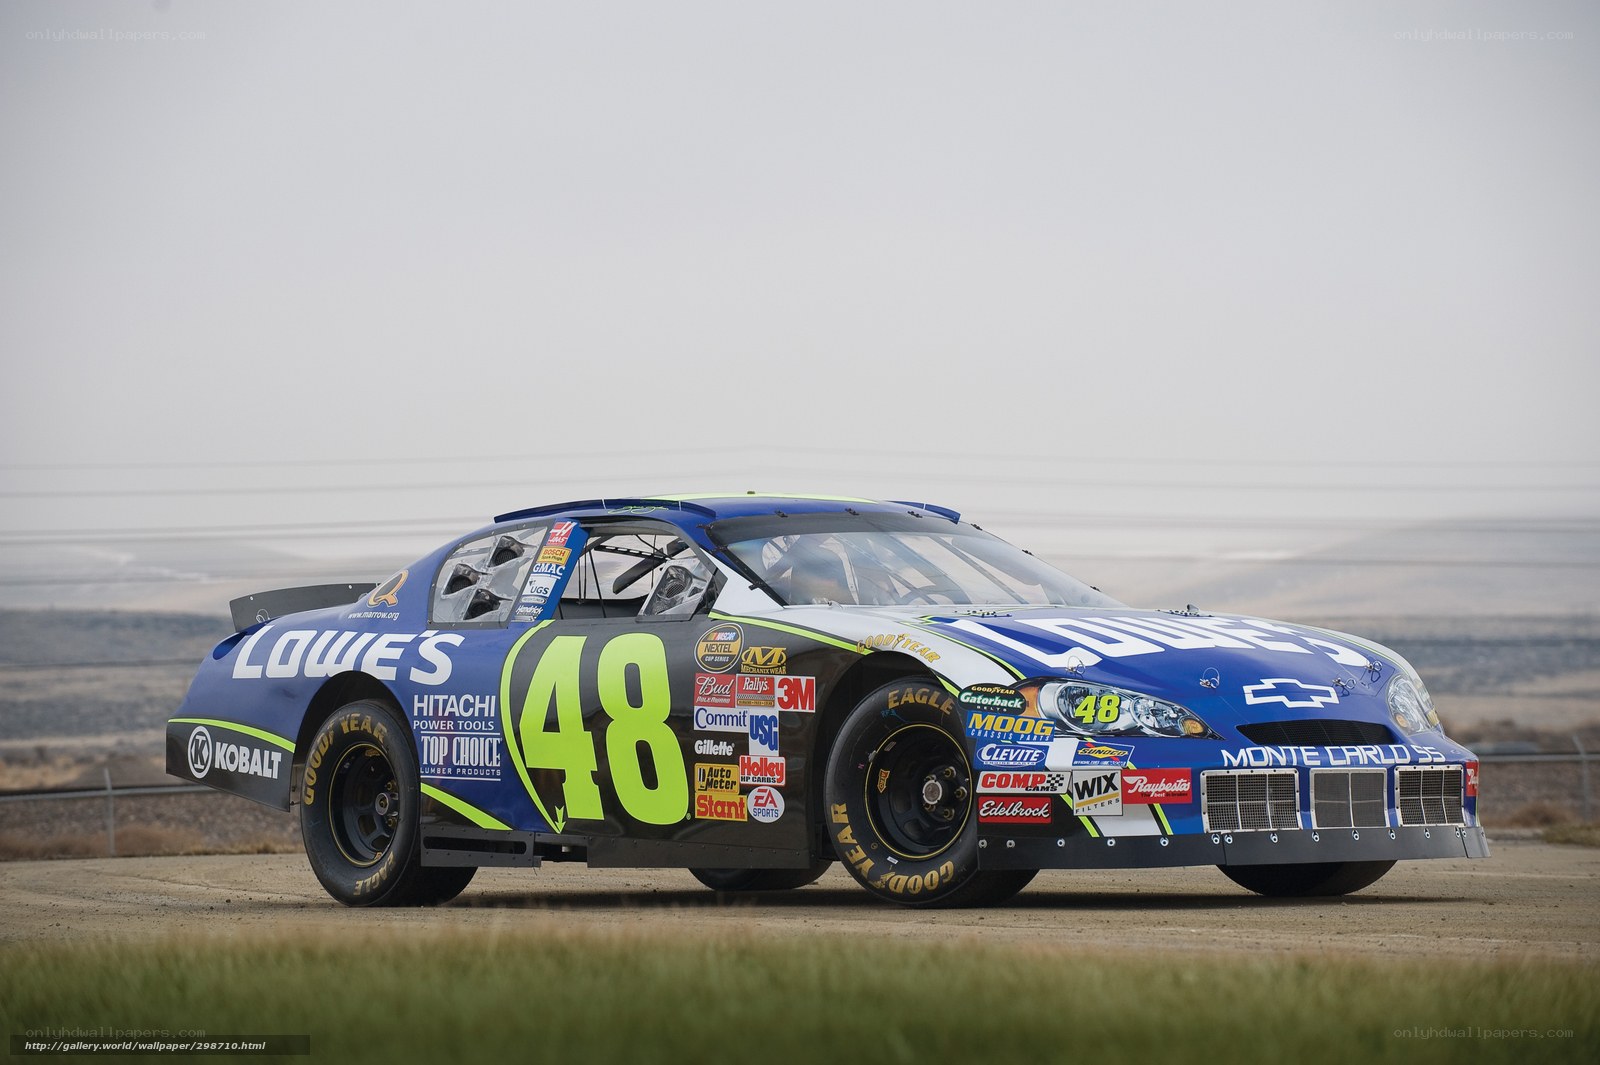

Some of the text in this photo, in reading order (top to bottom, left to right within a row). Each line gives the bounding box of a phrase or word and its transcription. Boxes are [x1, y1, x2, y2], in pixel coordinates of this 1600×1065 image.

[543, 549, 566, 557] BOSCH
[533, 563, 565, 575] GMAC
[530, 586, 549, 594] UGS
[348, 612, 400, 621] www.marrow.org
[516, 605, 543, 615] Hendrick
[714, 632, 736, 640] NASCAR
[232, 625, 465, 686] LOWE'S
[704, 644, 732, 653] NEXTEL
[741, 665, 787, 674] MECHANIX WEAR
[696, 676, 735, 695] Bud
[743, 677, 768, 693] Rally's
[971, 686, 1015, 695] GOODYEAR
[777, 678, 815, 710] 3M
[888, 688, 955, 715] EAGLE
[960, 692, 1023, 708] Gatorback
[413, 694, 496, 717] HITACHI
[1074, 695, 1120, 724] 48
[413, 720, 495, 731] POWER TOOLS
[695, 708, 747, 729] Commit
[968, 713, 1055, 736] MOOG
[519, 632, 690, 825] 48
[750, 715, 778, 751] USG
[971, 729, 1013, 740] CHASSIS
[421, 736, 501, 767] TOP CHOICE
[695, 739, 734, 756] Gillette
[981, 744, 1042, 761] CLEVITE
[1080, 748, 1127, 756] SUNOCO
[1221, 745, 1446, 767] MONTE CARLO SS
[215, 741, 282, 779] KOBALT
[456, 768, 501, 776] PRODUCTS
[707, 767, 731, 778] Auto
[741, 757, 784, 783] Holley
[705, 778, 736, 790] Meter
[981, 773, 1046, 788] COMP
[1074, 772, 1118, 800] WIX
[1123, 776, 1191, 798] Raybestos
[697, 794, 745, 819] Stant
[754, 788, 778, 808] EA
[1075, 798, 1120, 814] FILTERS
[753, 808, 779, 818] SPORTS
[980, 800, 1050, 817] Edelbrock
